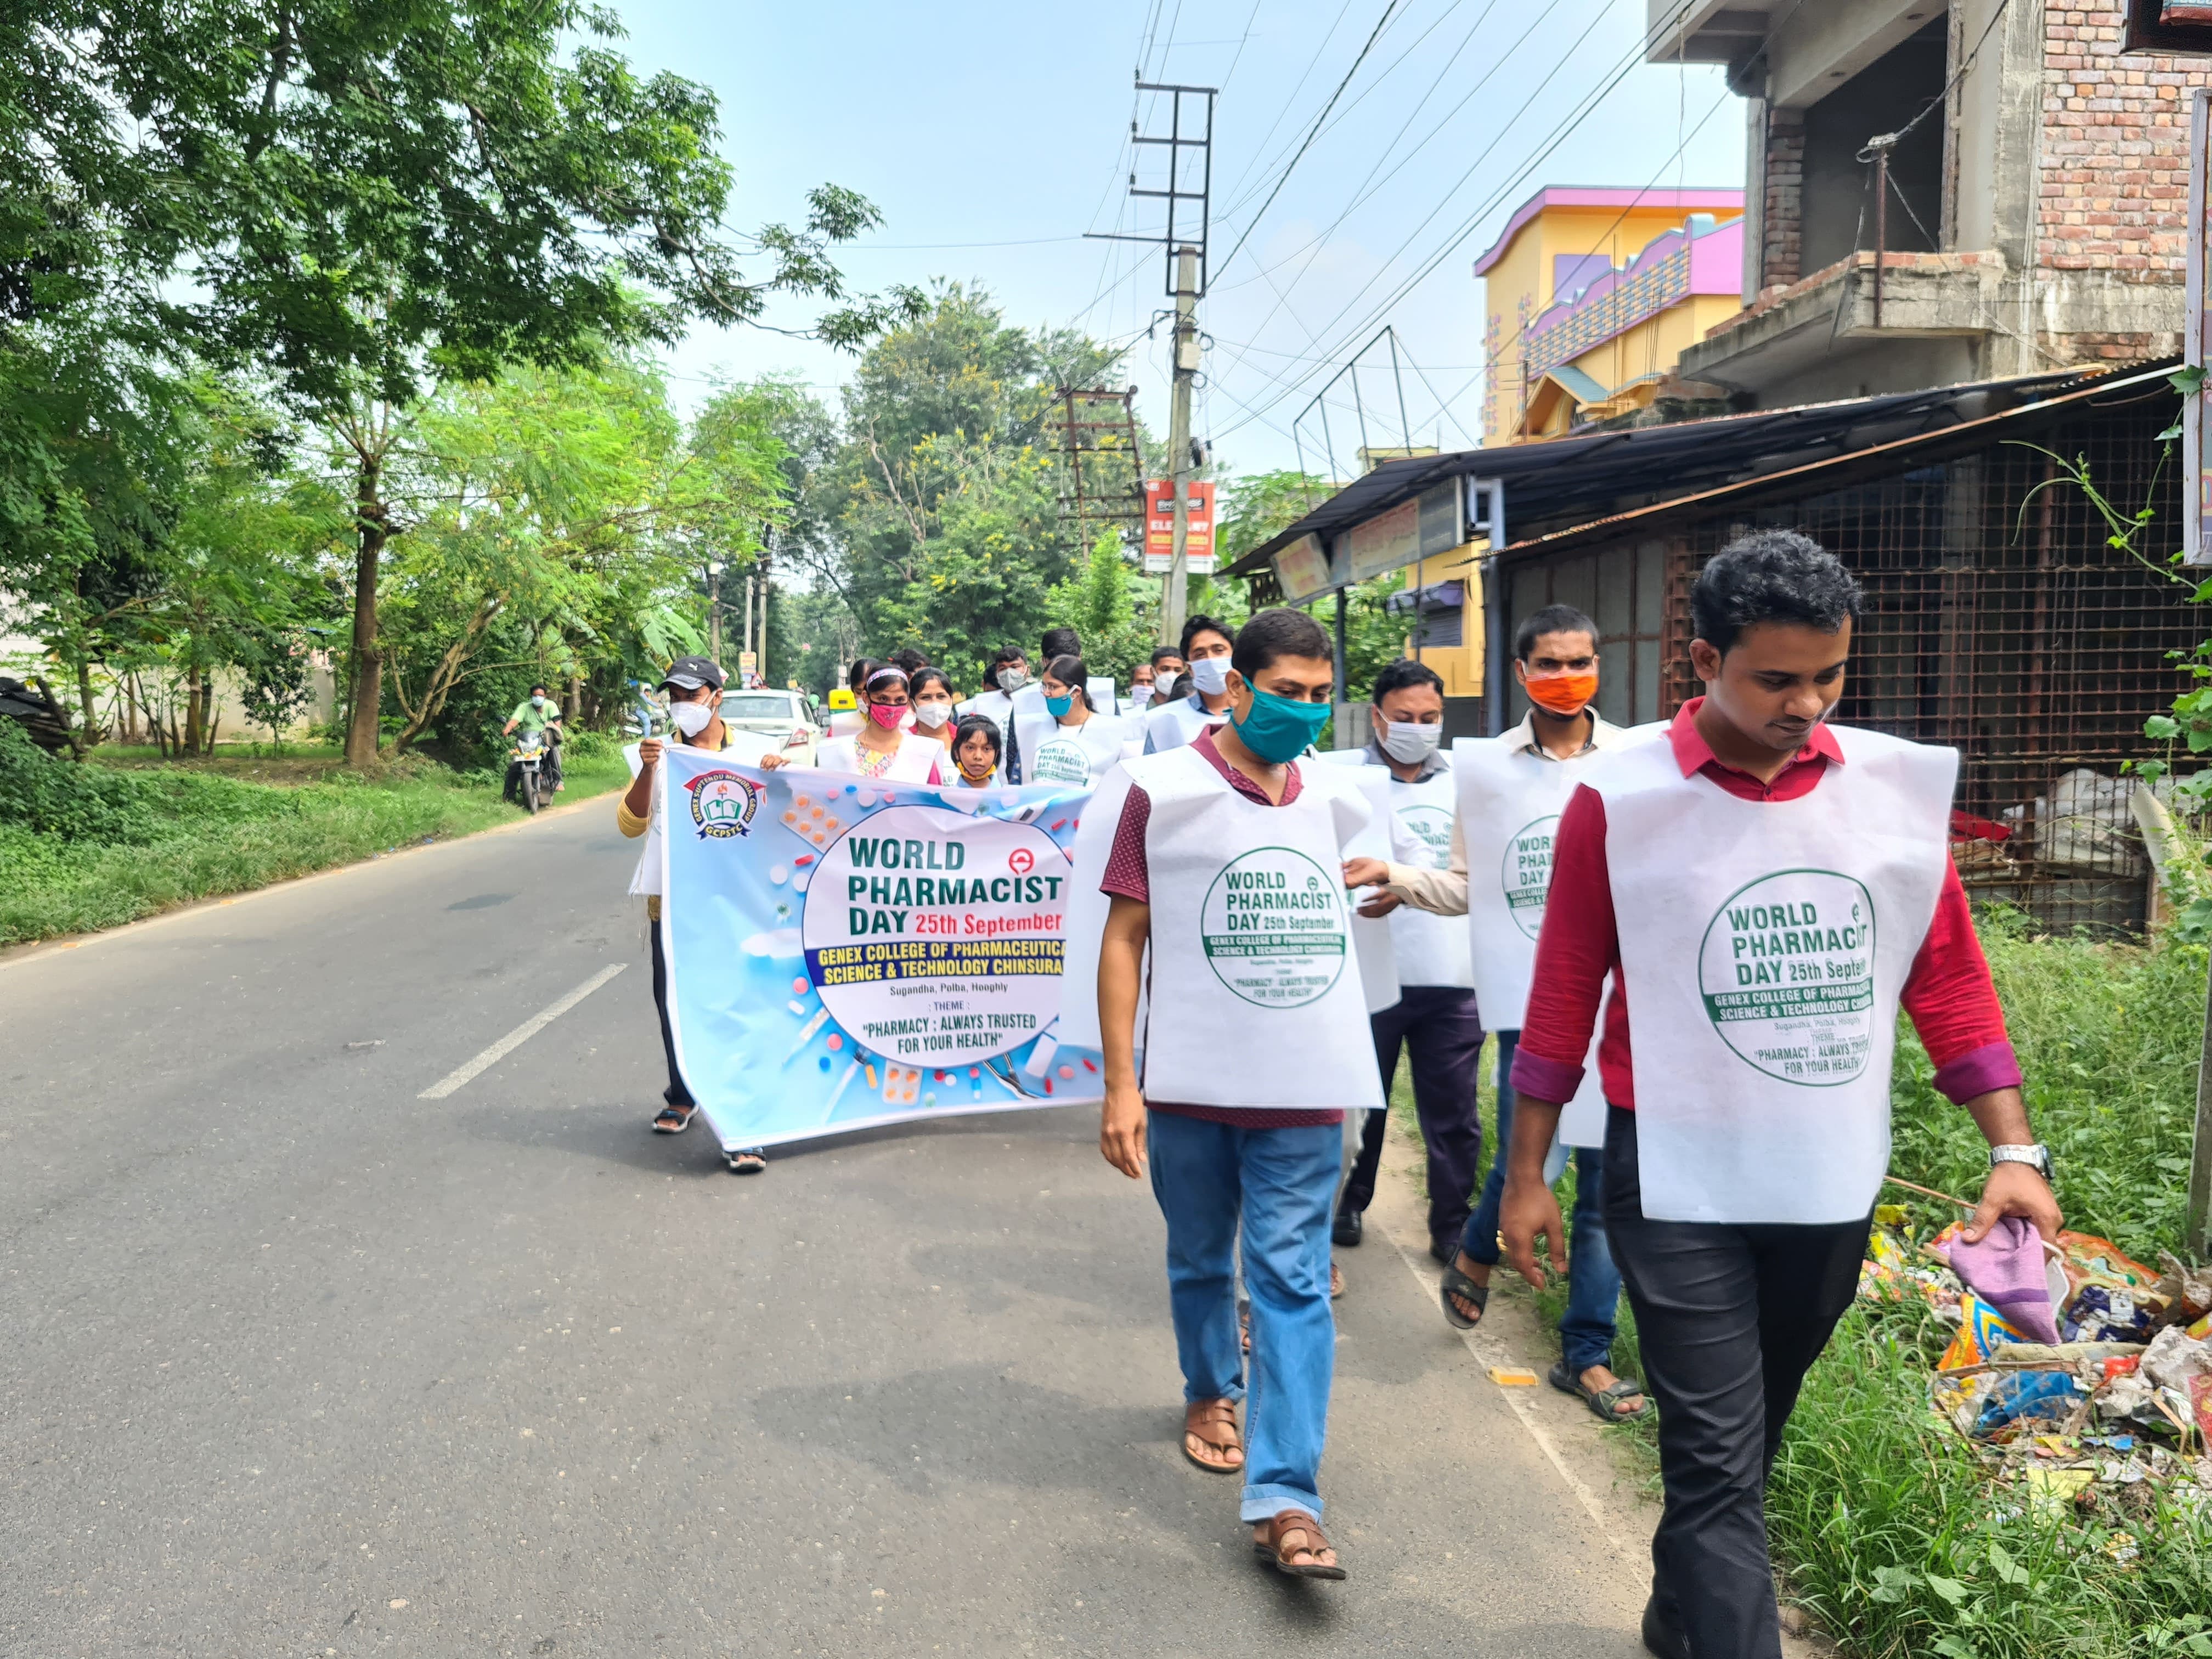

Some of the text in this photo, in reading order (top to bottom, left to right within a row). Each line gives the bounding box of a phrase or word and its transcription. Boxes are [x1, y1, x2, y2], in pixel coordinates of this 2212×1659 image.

[693, 774, 756, 822] GENEX SUPTENDU MEMORIAL GROUP
[705, 824, 743, 837] GCPSTC
[849, 837, 965, 870] WORLD
[1516, 836, 1554, 851] WOR
[1226, 871, 1286, 890] WORLD
[1519, 870, 1544, 885] DAY
[848, 876, 1063, 906] PHARMACIST
[1227, 892, 1331, 910] PHARMACIST
[849, 907, 1063, 937] DAY 25th September
[1227, 913, 1334, 931] DAY 25th September
[1726, 901, 1817, 932] WORLD
[819, 947, 863, 966] GENEX
[866, 943, 926, 961] COLLEGE
[931, 943, 949, 957] OF
[825, 965, 882, 985] SCIENCE
[886, 964, 896, 978] &
[901, 960, 989, 977] TECHNOLOGY
[1735, 960, 1782, 986] DAY
[1788, 962, 1822, 982] 25th
[890, 983, 1008, 996] Sugandha, Polba, Hooghly
[1714, 993, 1749, 1007] GENEX
[1752, 989, 1801, 1005] COLLEGE
[1803, 987, 1818, 1001] OF
[934, 1001, 964, 1011] THEME
[1719, 1005, 1767, 1021] SCIENCE
[1770, 1005, 1779, 1017] &
[1782, 998, 1850, 1016] TECHNOLOGY
[863, 1017, 929, 1039] "PHARMACY
[941, 1015, 984, 1031] ALWAYS
[988, 1013, 1036, 1029] TRUSTED
[898, 1032, 1003, 1054] FOR YOUR HEALTH"
[1818, 1042, 1850, 1057] ALWAYS
[1784, 1062, 1803, 1074] FOR
[1805, 1060, 1829, 1074] YOUR
